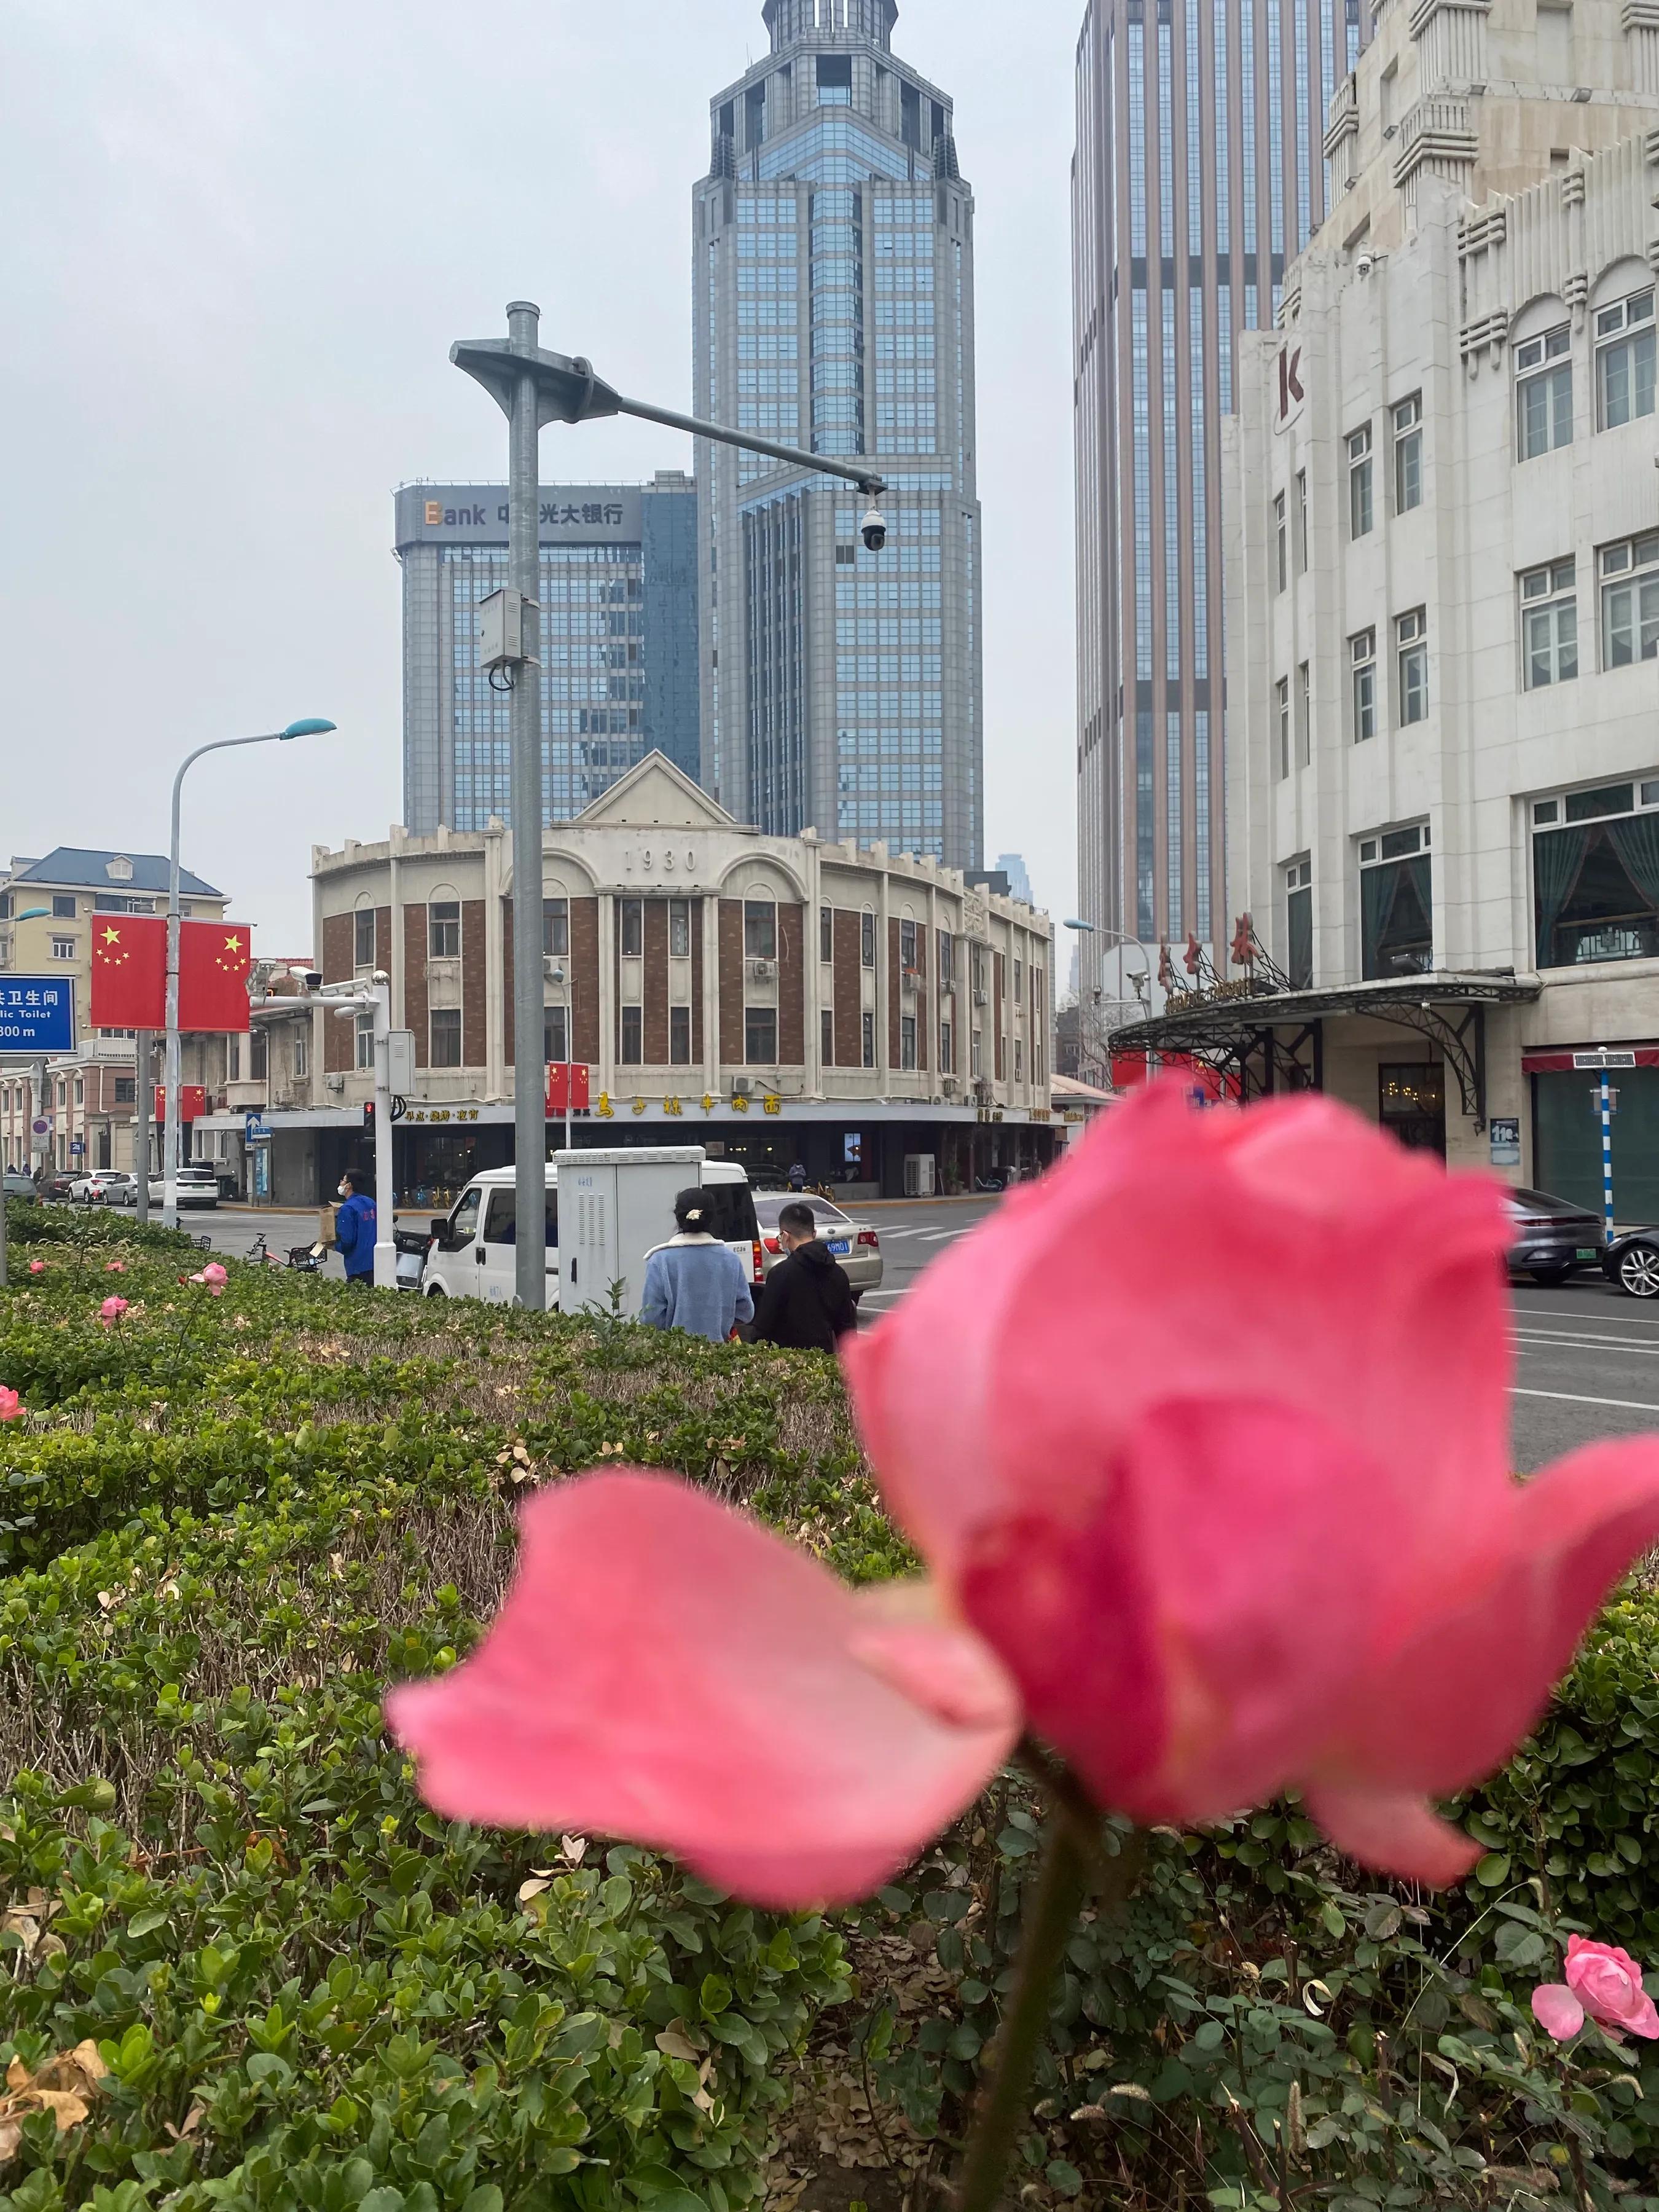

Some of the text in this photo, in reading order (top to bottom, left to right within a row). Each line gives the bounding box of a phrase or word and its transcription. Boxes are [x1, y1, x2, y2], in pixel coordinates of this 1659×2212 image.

[498, 503, 623, 525] 中光大银行
[625, 849, 696, 871] 1930
[0, 1010, 51, 1018] lic Toilet
[23, 1029, 35, 1037] m
[827, 1242, 848, 1252] 69M01
